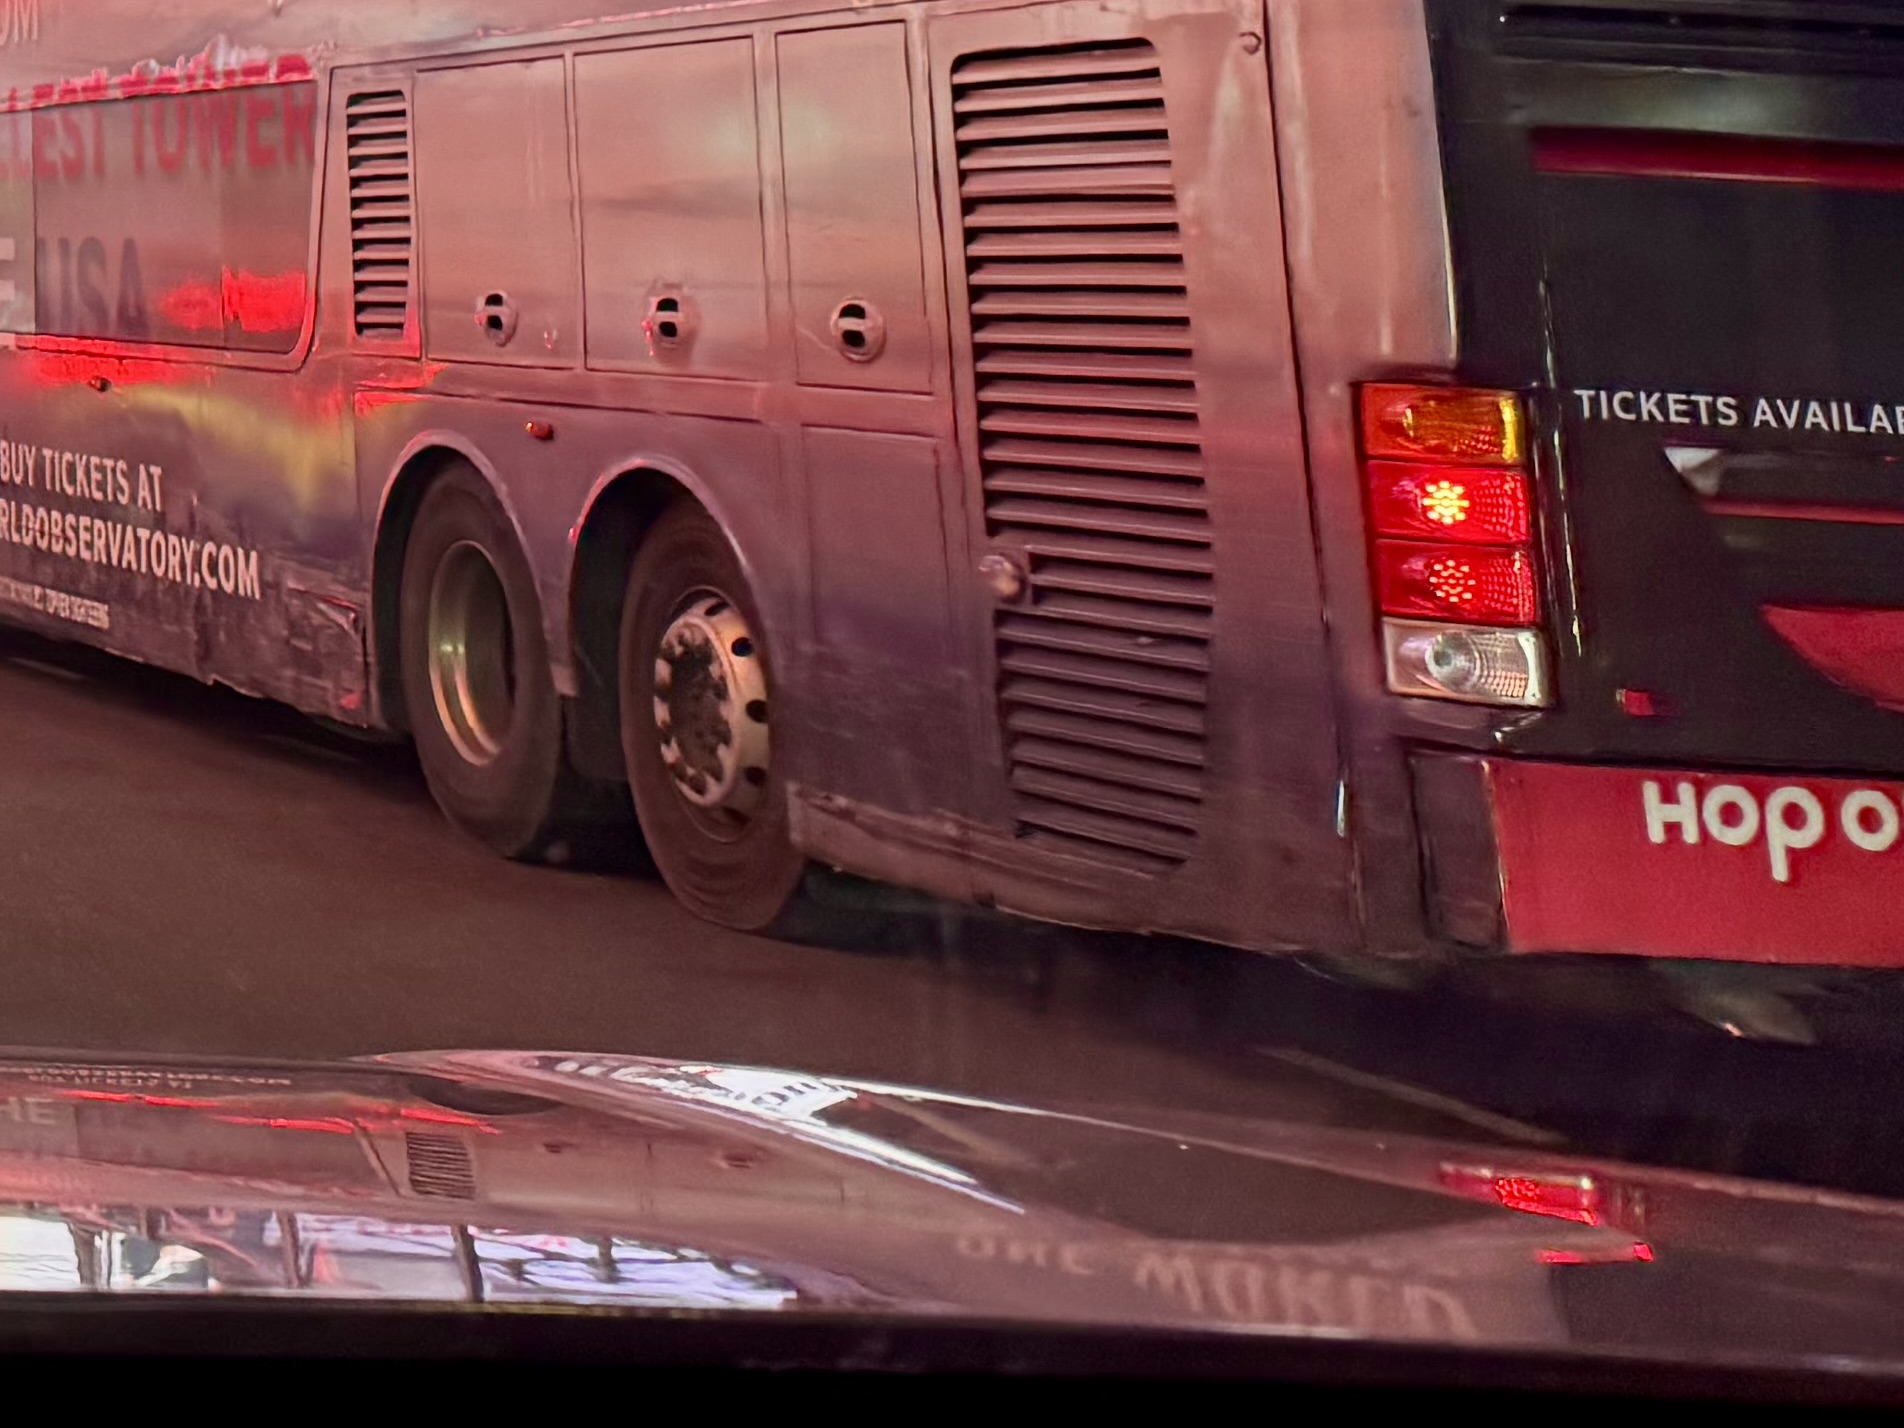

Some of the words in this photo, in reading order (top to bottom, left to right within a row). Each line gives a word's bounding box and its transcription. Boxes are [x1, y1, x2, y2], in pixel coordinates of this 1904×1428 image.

[34, 235, 150, 342] USA
[1573, 387, 1739, 427] TICKETS
[42, 447, 131, 506] TICKETS
[136, 462, 163, 513] AT
